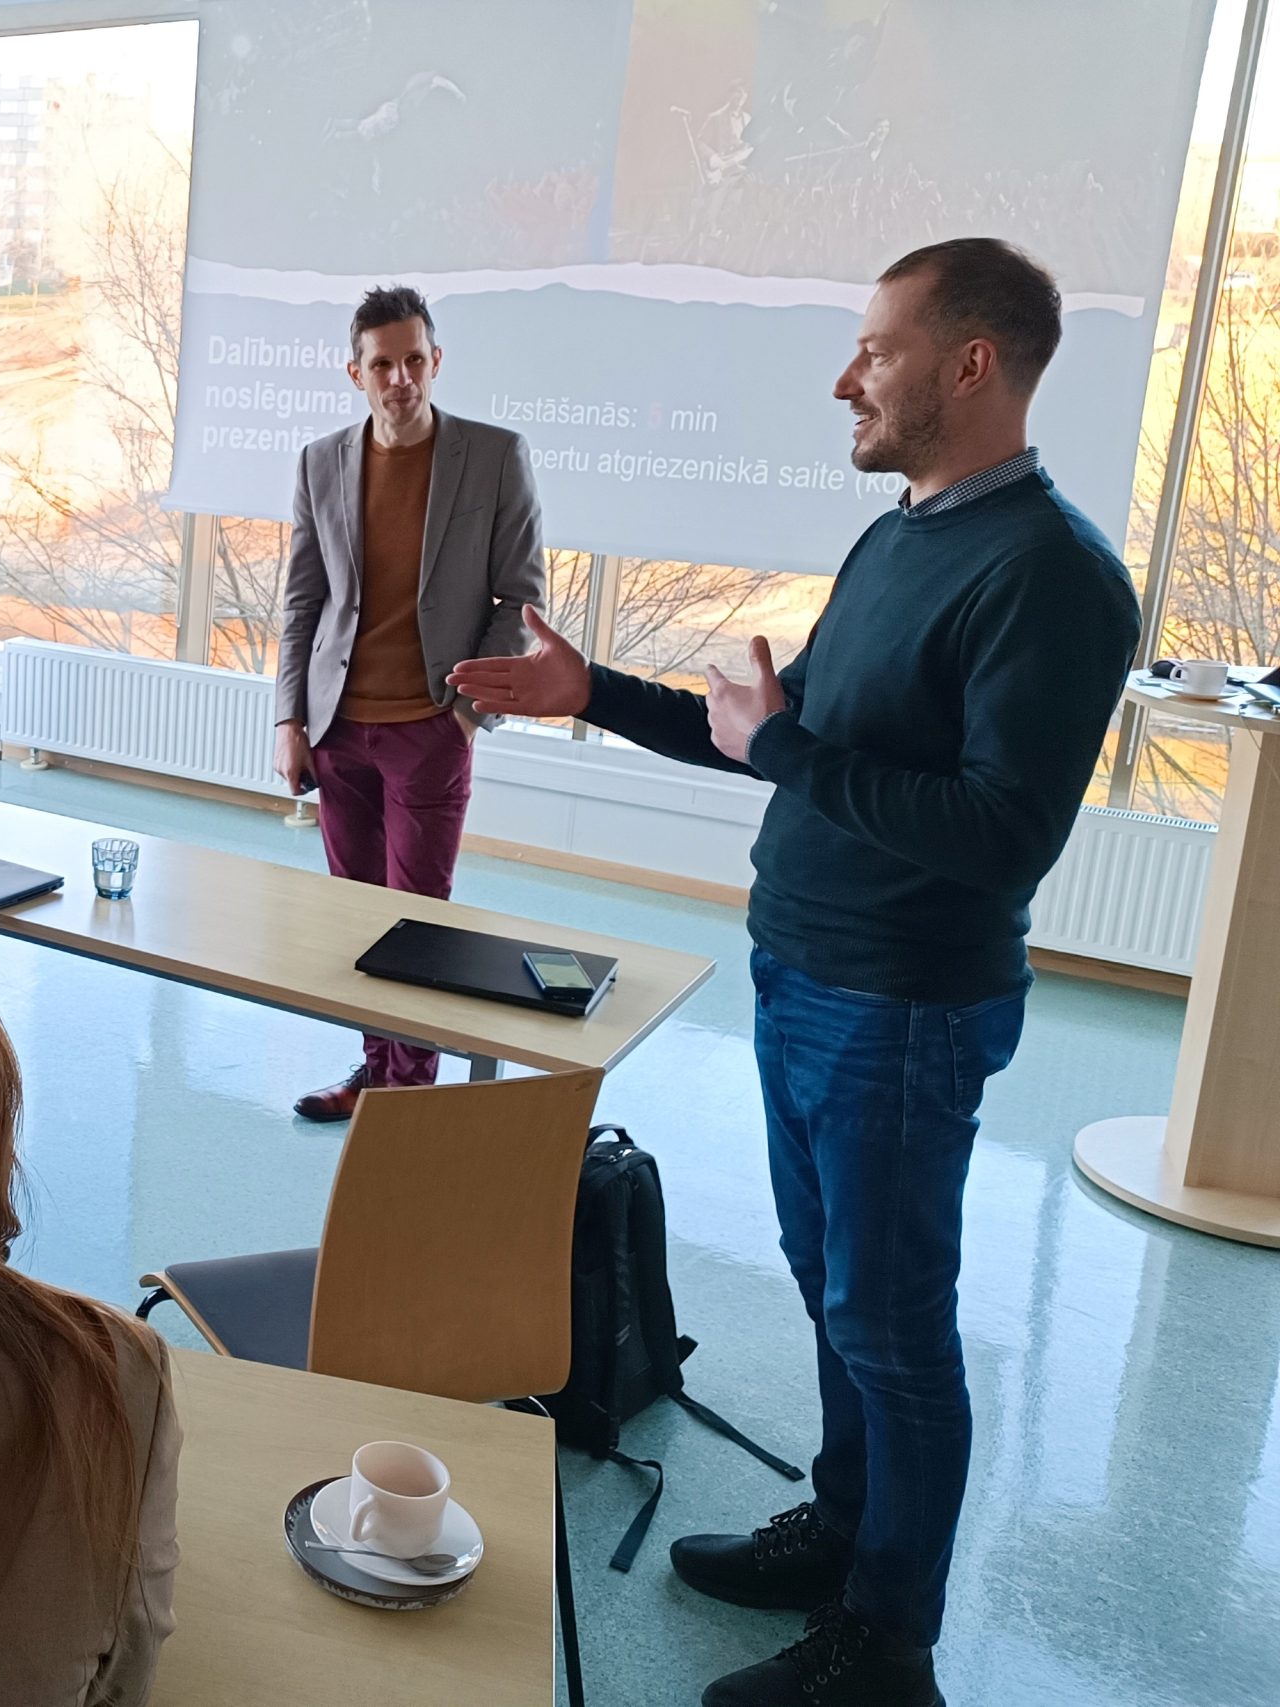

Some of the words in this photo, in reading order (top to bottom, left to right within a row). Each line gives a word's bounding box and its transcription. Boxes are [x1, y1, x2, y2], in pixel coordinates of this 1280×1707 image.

[207, 334, 350, 369] Dalībnieku
[205, 380, 353, 419] noslēguma
[490, 393, 639, 429] Uzstāšanās:
[670, 404, 718, 433] min
[202, 424, 341, 454] prezentā
[530, 445, 590, 472] pertu
[596, 448, 769, 486] atgriezeniskā
[777, 461, 846, 491] saite
[854, 471, 906, 500] (ko
